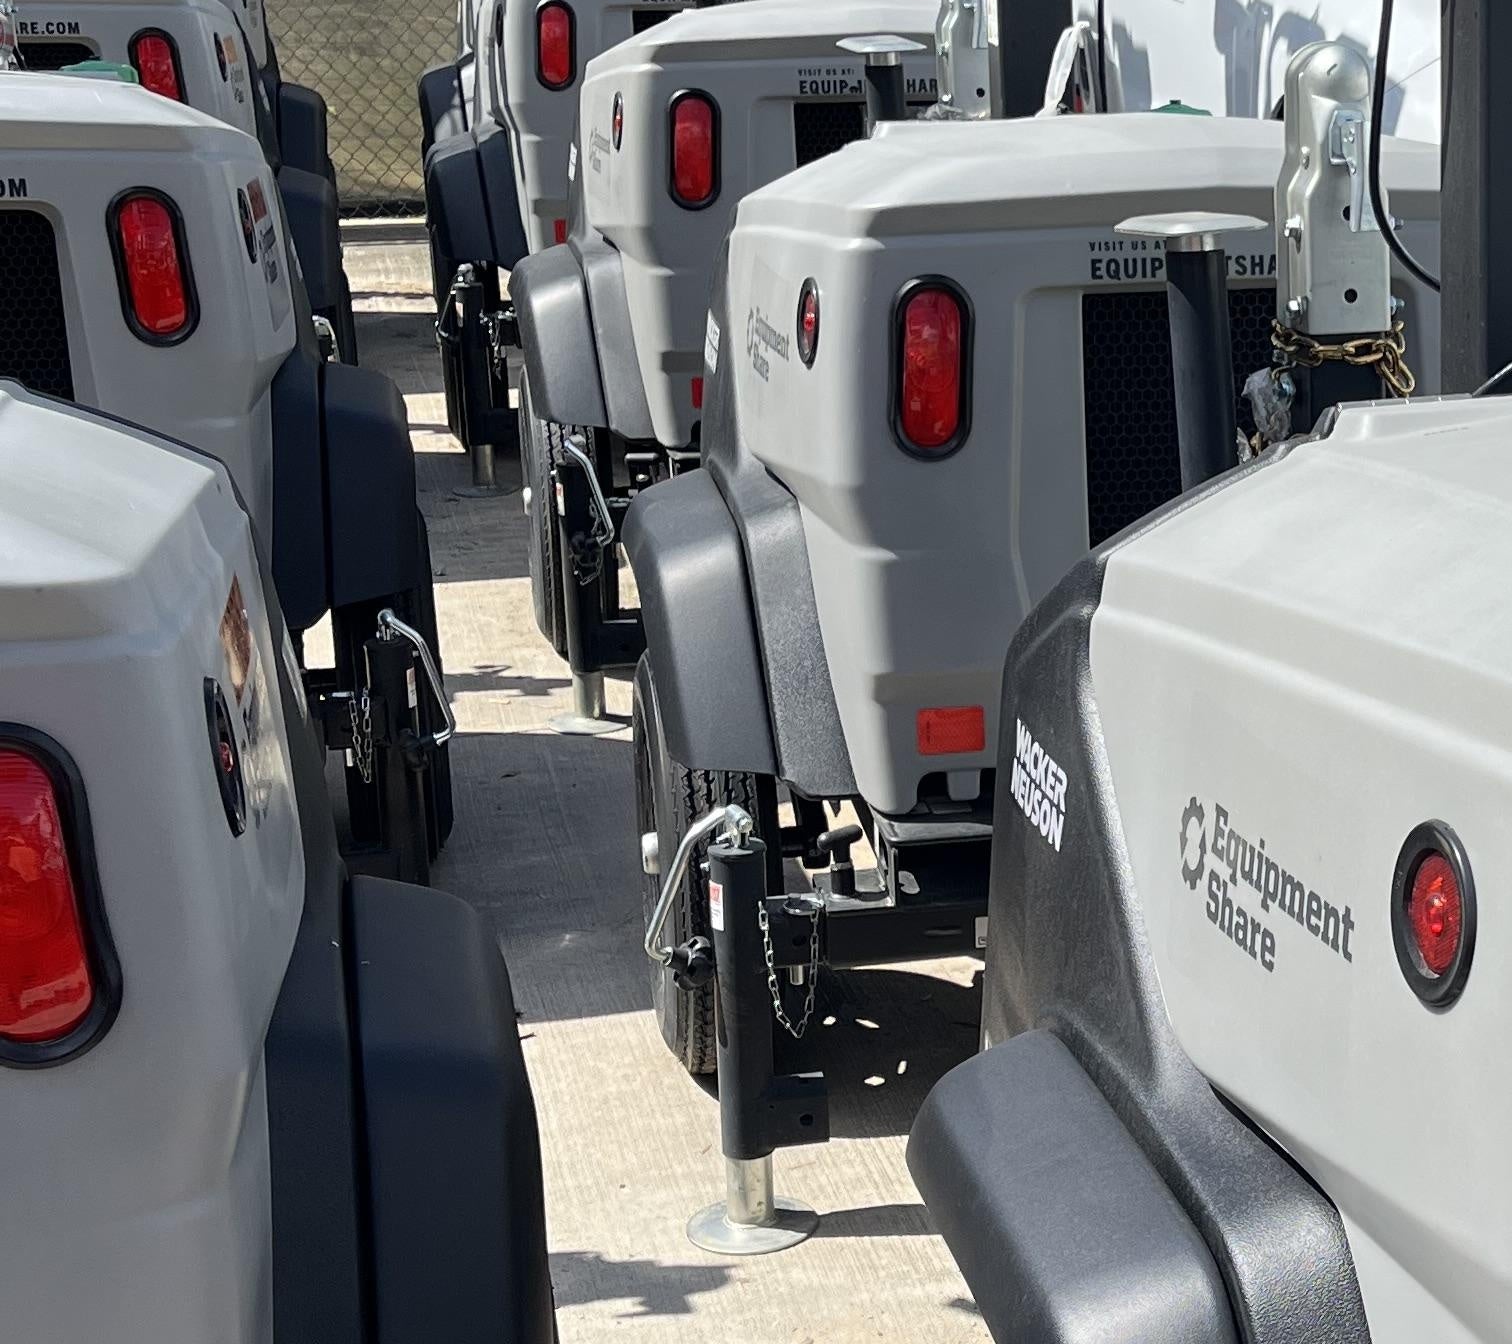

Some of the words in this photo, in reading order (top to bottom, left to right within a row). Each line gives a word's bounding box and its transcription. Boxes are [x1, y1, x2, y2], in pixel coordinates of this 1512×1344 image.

[15, 22, 80, 35] RE.COM
[1089, 241, 1124, 252] VISIT
[1131, 240, 1147, 251] US
[1010, 757, 1065, 852] NEUSON
[1016, 718, 1068, 813] WACKER
[1206, 868, 1276, 973] Share
[1211, 802, 1355, 963] Equipment
